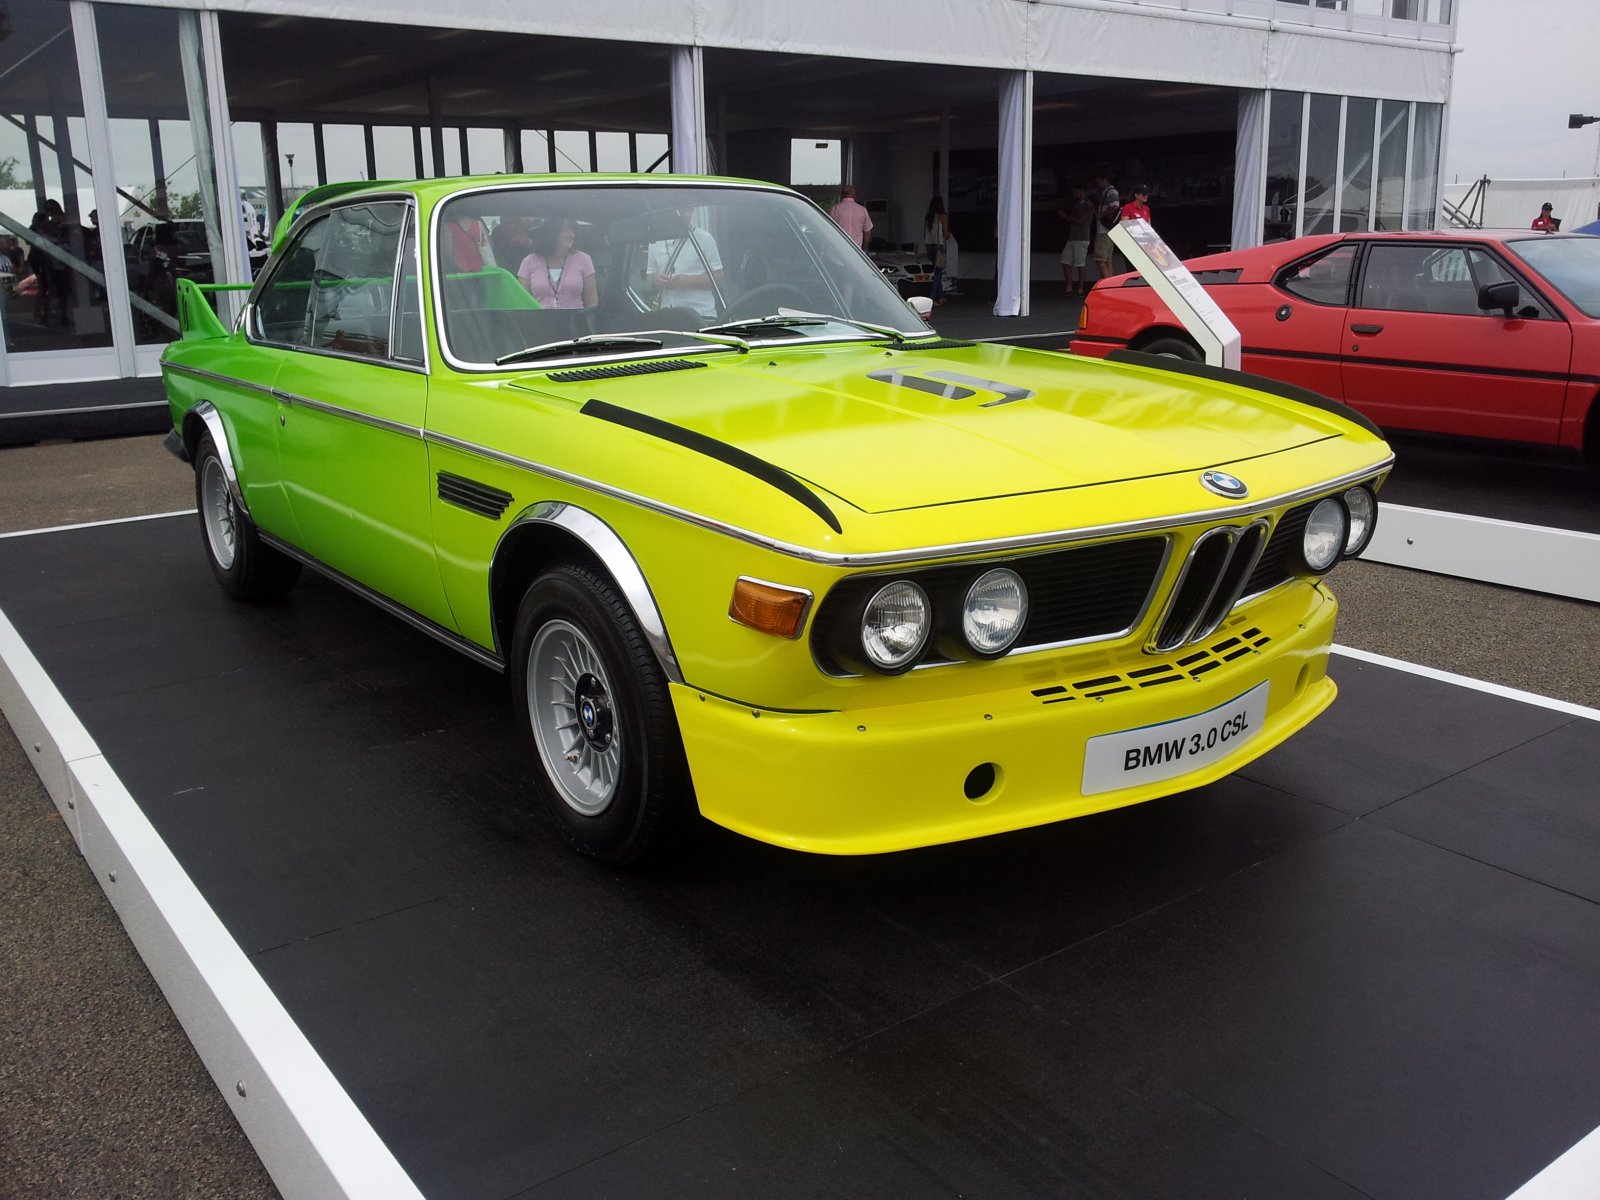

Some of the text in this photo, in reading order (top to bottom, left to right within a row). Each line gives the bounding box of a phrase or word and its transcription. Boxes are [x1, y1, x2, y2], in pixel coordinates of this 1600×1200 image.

[1124, 711, 1249, 771] BMW 3.0 CSL
